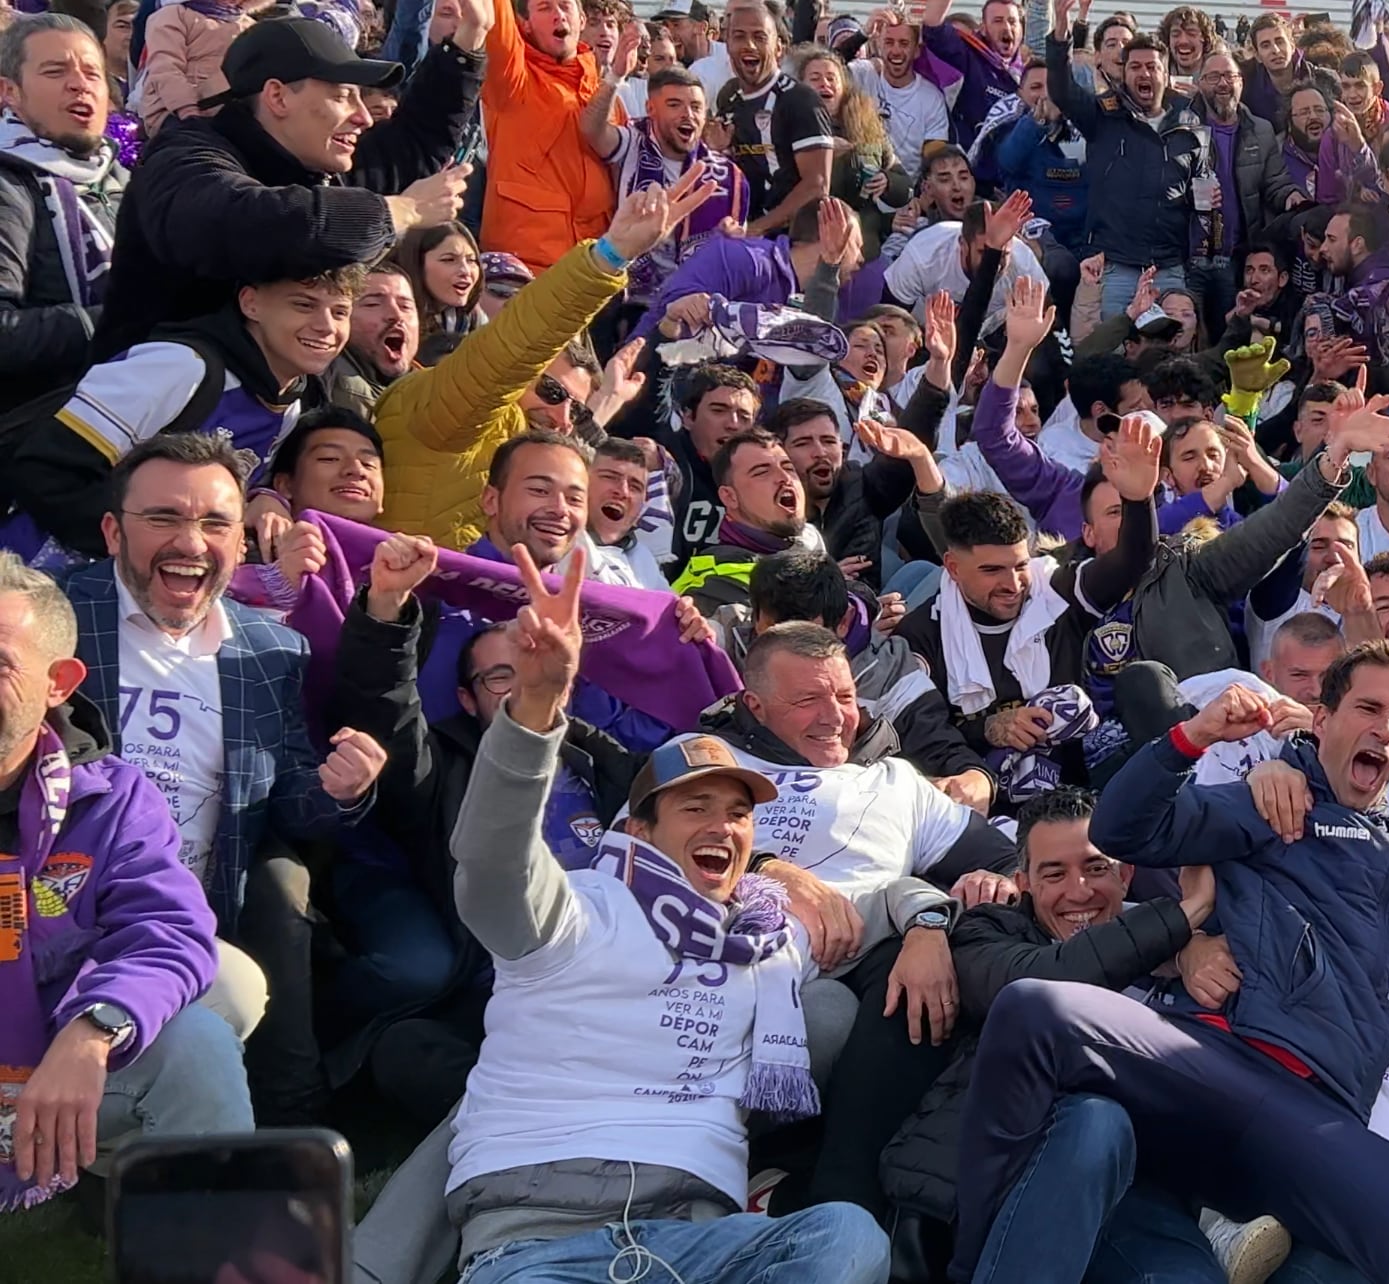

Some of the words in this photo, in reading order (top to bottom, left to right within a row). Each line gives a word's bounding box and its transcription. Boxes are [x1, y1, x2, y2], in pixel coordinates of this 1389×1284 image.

[119, 685, 181, 741] 75
[147, 744, 182, 759] PARA
[162, 759, 180, 771] MI
[787, 794, 817, 807] PARA
[765, 806, 787, 815] VER
[788, 806, 797, 814] A
[800, 806, 816, 818] MI
[771, 828, 806, 845] CAM
[1314, 821, 1371, 841] hummel
[780, 845, 800, 859] PE
[648, 986, 690, 1000] AÑOS
[693, 991, 725, 1007] PARA
[666, 1001, 692, 1015] VER
[695, 1006, 705, 1017] A
[676, 1035, 715, 1053] CAM
[688, 1056, 709, 1069] PE
